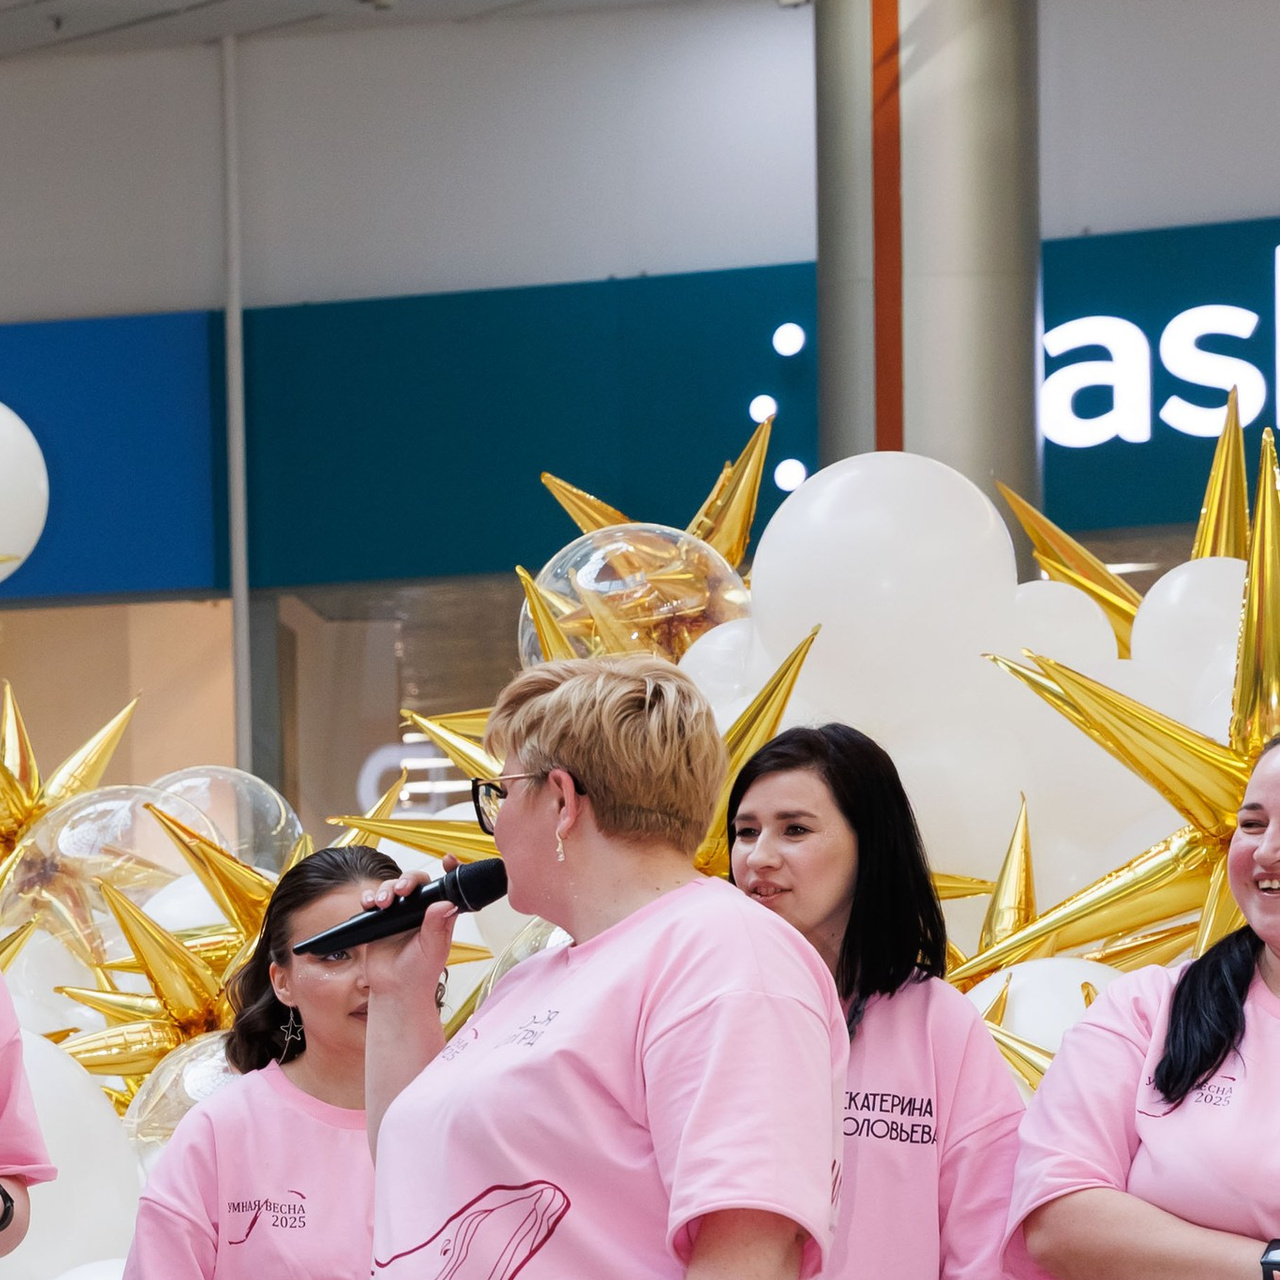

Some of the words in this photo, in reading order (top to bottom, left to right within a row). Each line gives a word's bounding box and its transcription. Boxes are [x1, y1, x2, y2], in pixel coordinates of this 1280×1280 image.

[1038, 244, 1280, 448] as
[1194, 1081, 1233, 1096] ЕСНА
[844, 1091, 933, 1118] КАТЕРИНА
[1194, 1091, 1232, 1107] 2025
[227, 1200, 261, 1213] УМНАЯ
[265, 1201, 306, 1215] ВЕСНА
[271, 1214, 306, 1229] 2025
